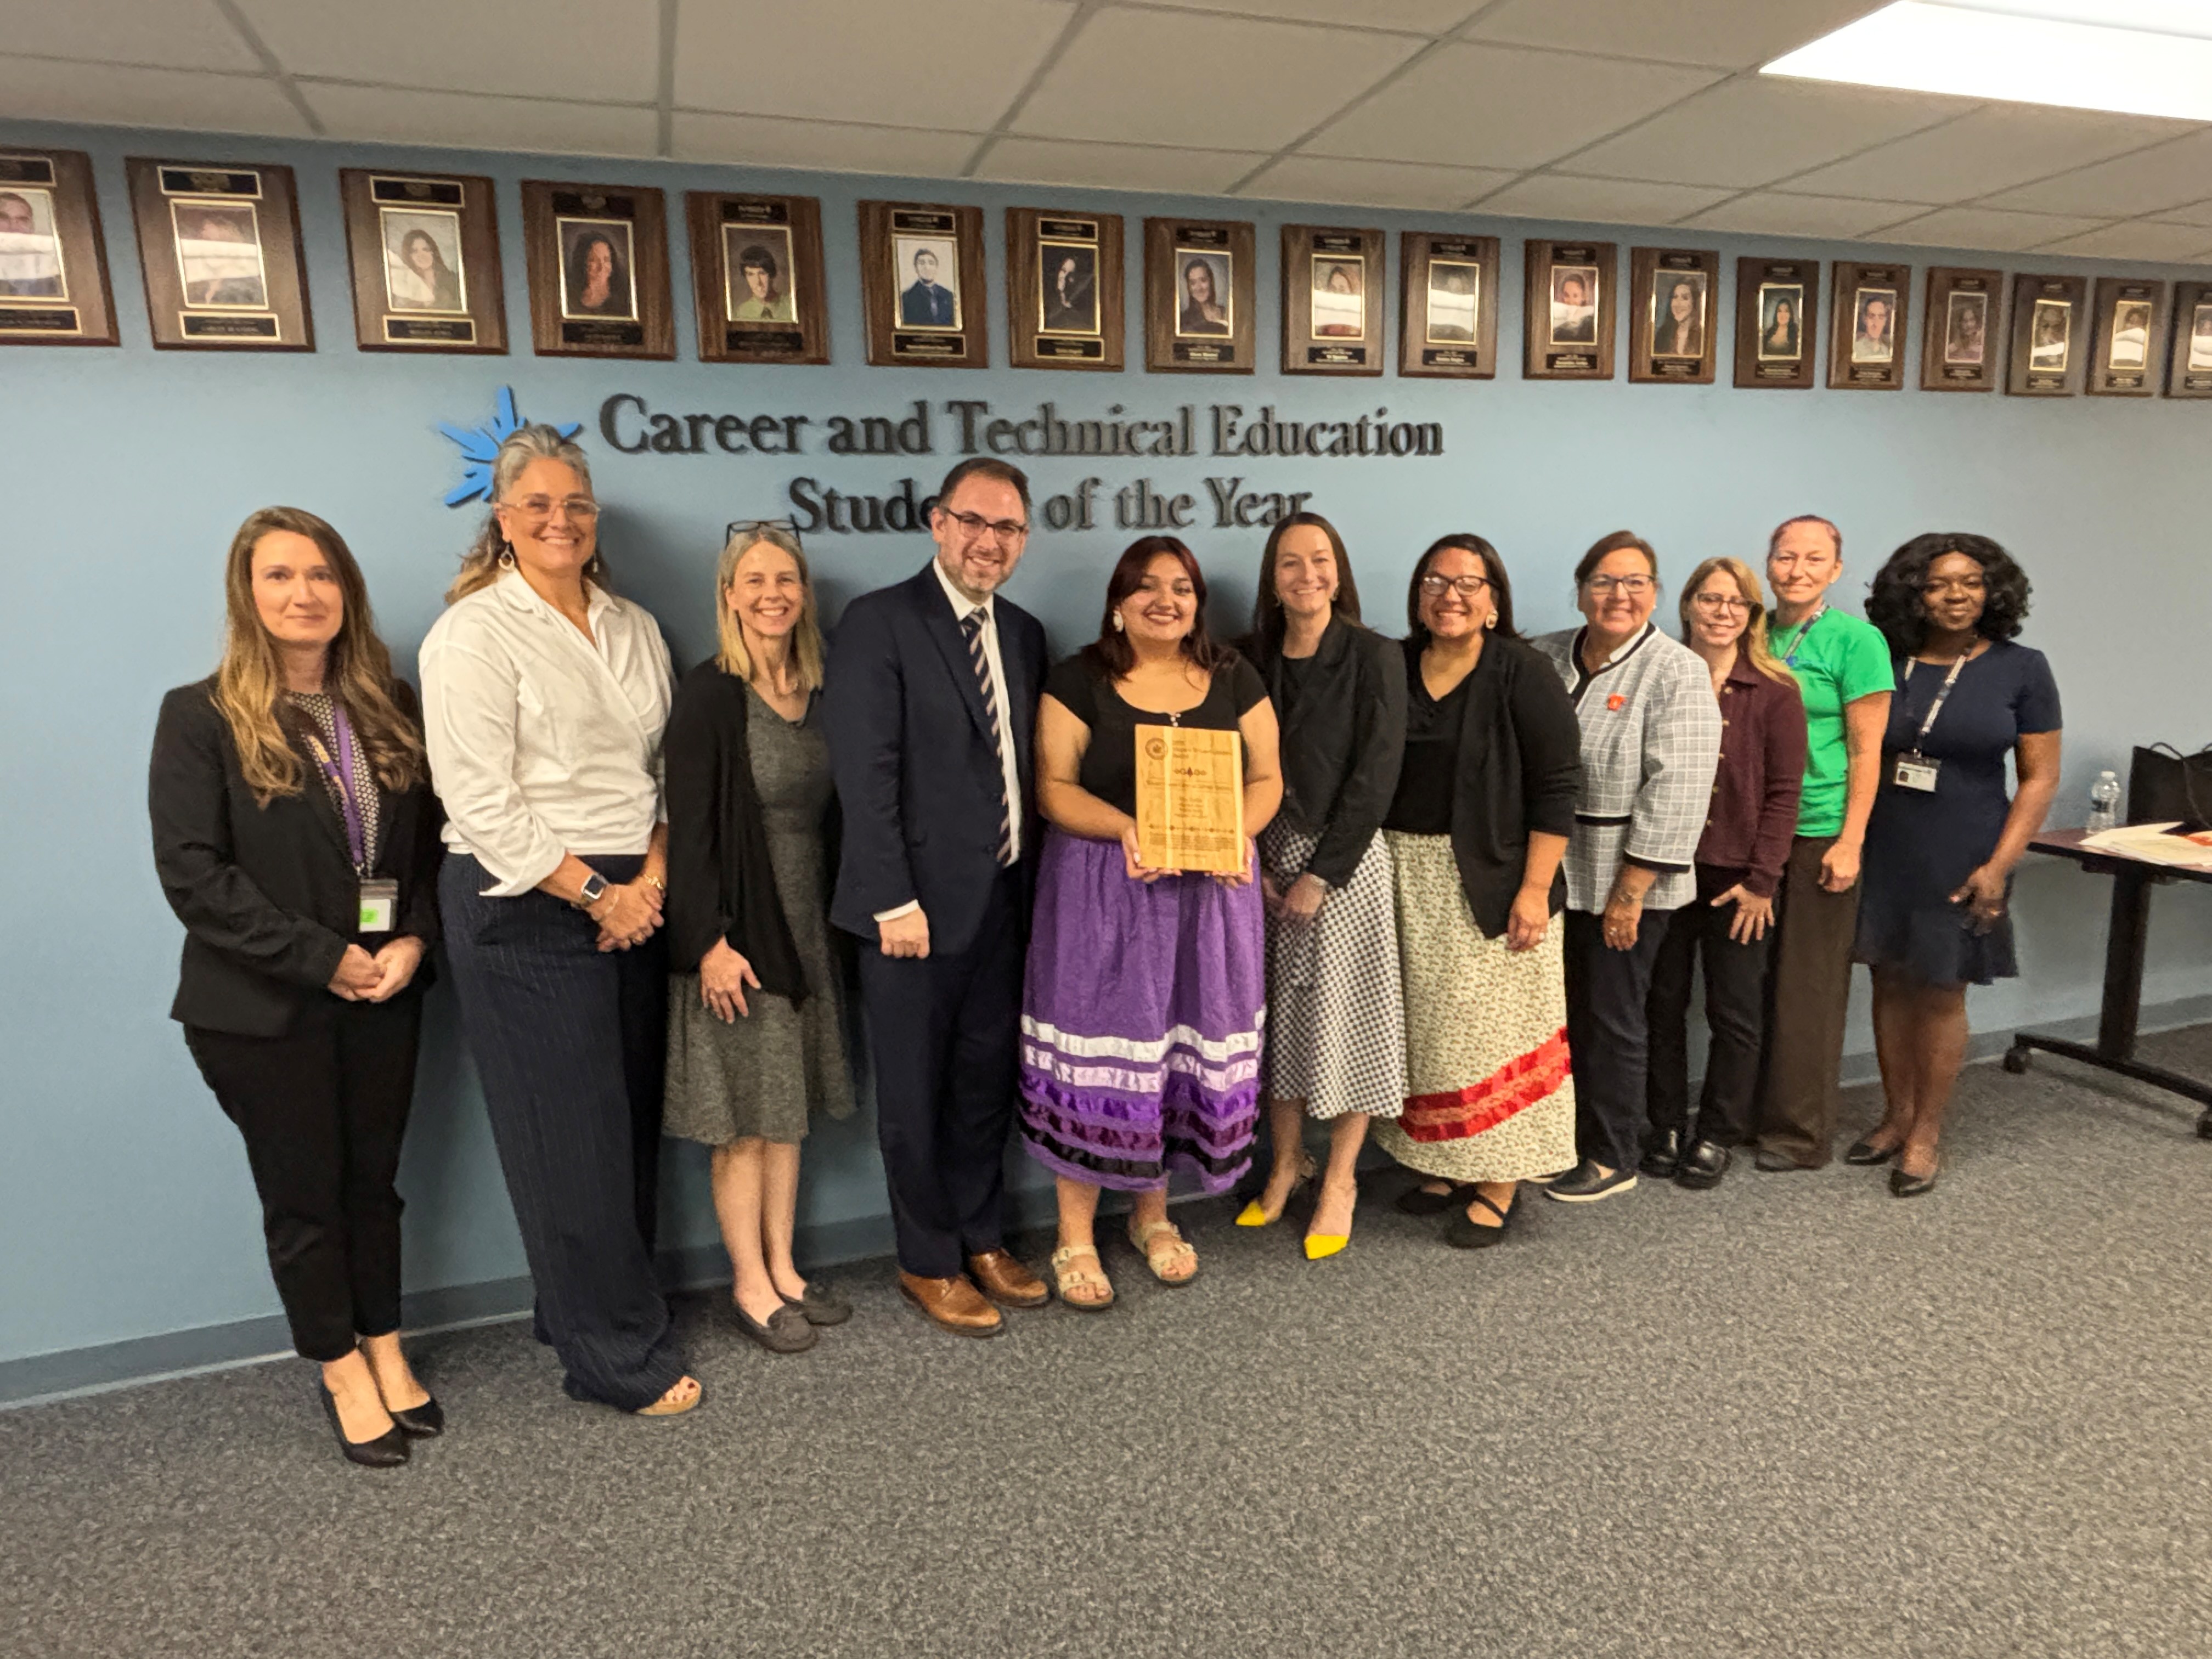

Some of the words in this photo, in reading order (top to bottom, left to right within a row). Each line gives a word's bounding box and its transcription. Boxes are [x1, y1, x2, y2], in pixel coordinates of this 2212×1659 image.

[599, 393, 810, 454] Career
[827, 400, 934, 454] and
[945, 400, 1197, 456] Technical
[1210, 404, 1445, 457] Education
[789, 476, 940, 533] Stude
[1044, 477, 1102, 531] of
[1115, 478, 1196, 529] the
[1202, 476, 1313, 528] Year
